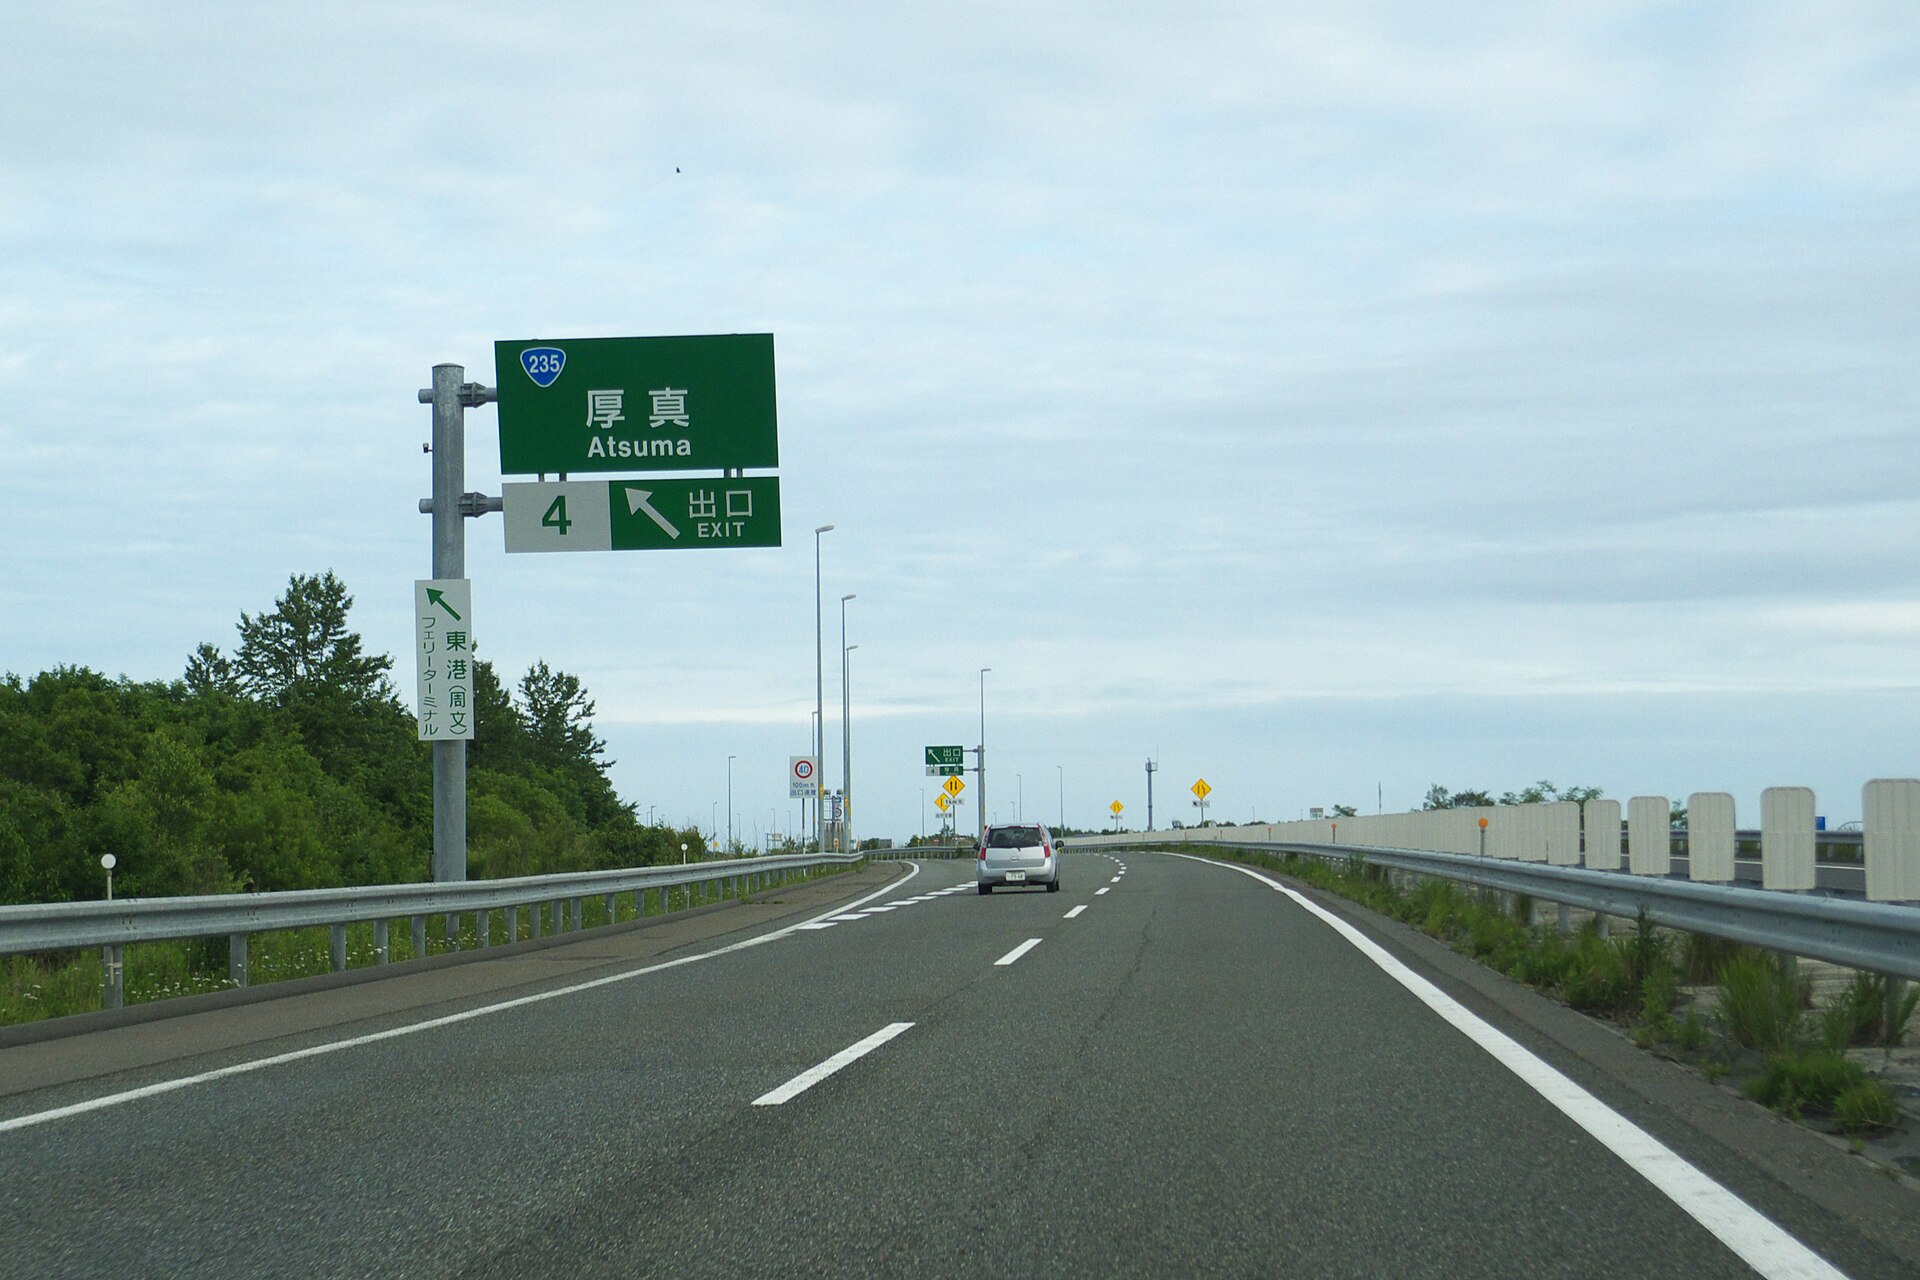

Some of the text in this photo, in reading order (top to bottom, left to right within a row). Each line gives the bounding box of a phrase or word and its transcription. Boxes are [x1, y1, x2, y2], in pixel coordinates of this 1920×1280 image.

[529, 355, 560, 374] 235
[585, 386, 690, 430] 厚真
[587, 436, 692, 458] Atsuma
[688, 489, 753, 519] 出口
[541, 495, 572, 536] 4
[697, 521, 745, 539] EXIT
[422, 617, 438, 736] フェリーターミナル
[943, 748, 961, 757] 出口
[798, 764, 809, 774] 40
